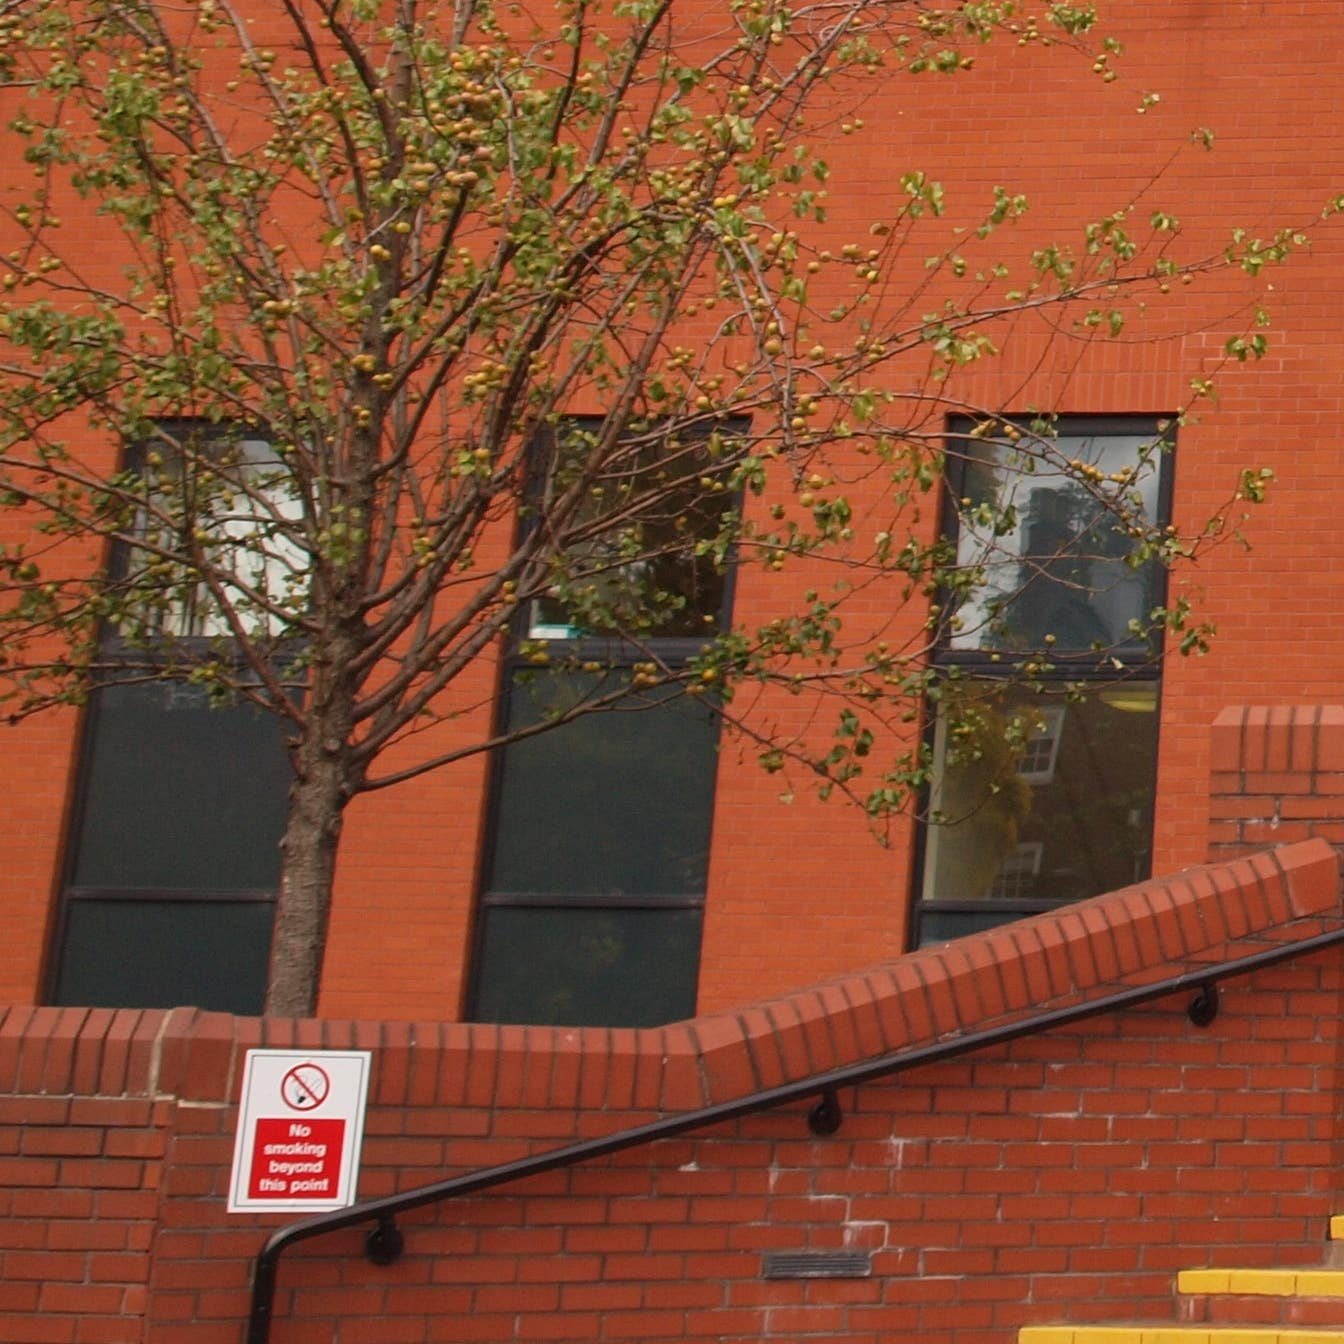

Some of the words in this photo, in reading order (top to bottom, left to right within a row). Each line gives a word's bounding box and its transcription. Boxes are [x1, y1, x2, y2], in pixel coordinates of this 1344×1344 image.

[289, 1124, 311, 1137] No
[264, 1142, 327, 1157] smoking
[269, 1160, 323, 1175] beyond
[260, 1178, 286, 1192] this
[290, 1179, 329, 1194] point
